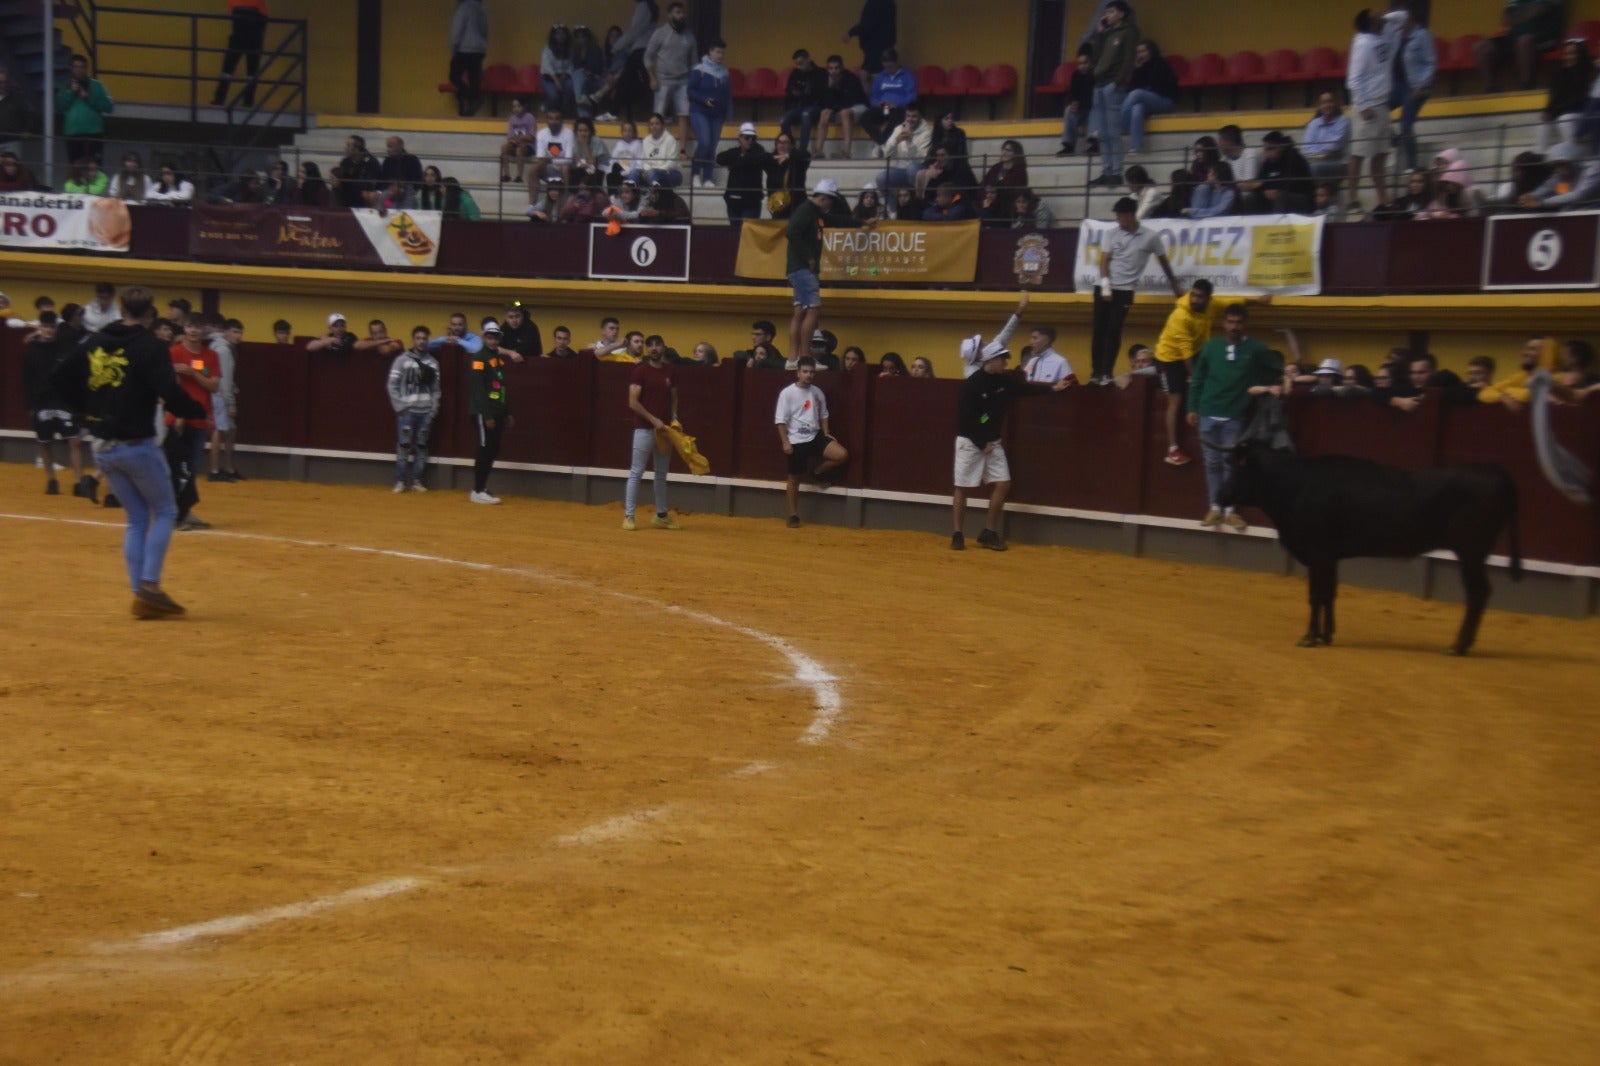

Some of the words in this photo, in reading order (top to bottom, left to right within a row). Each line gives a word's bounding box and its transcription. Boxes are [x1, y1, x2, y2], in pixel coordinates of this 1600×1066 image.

[1, 211, 57, 238] RO
[635, 238, 652, 265] 6
[1158, 226, 1245, 266] OMEZ
[1531, 231, 1557, 268] 5
